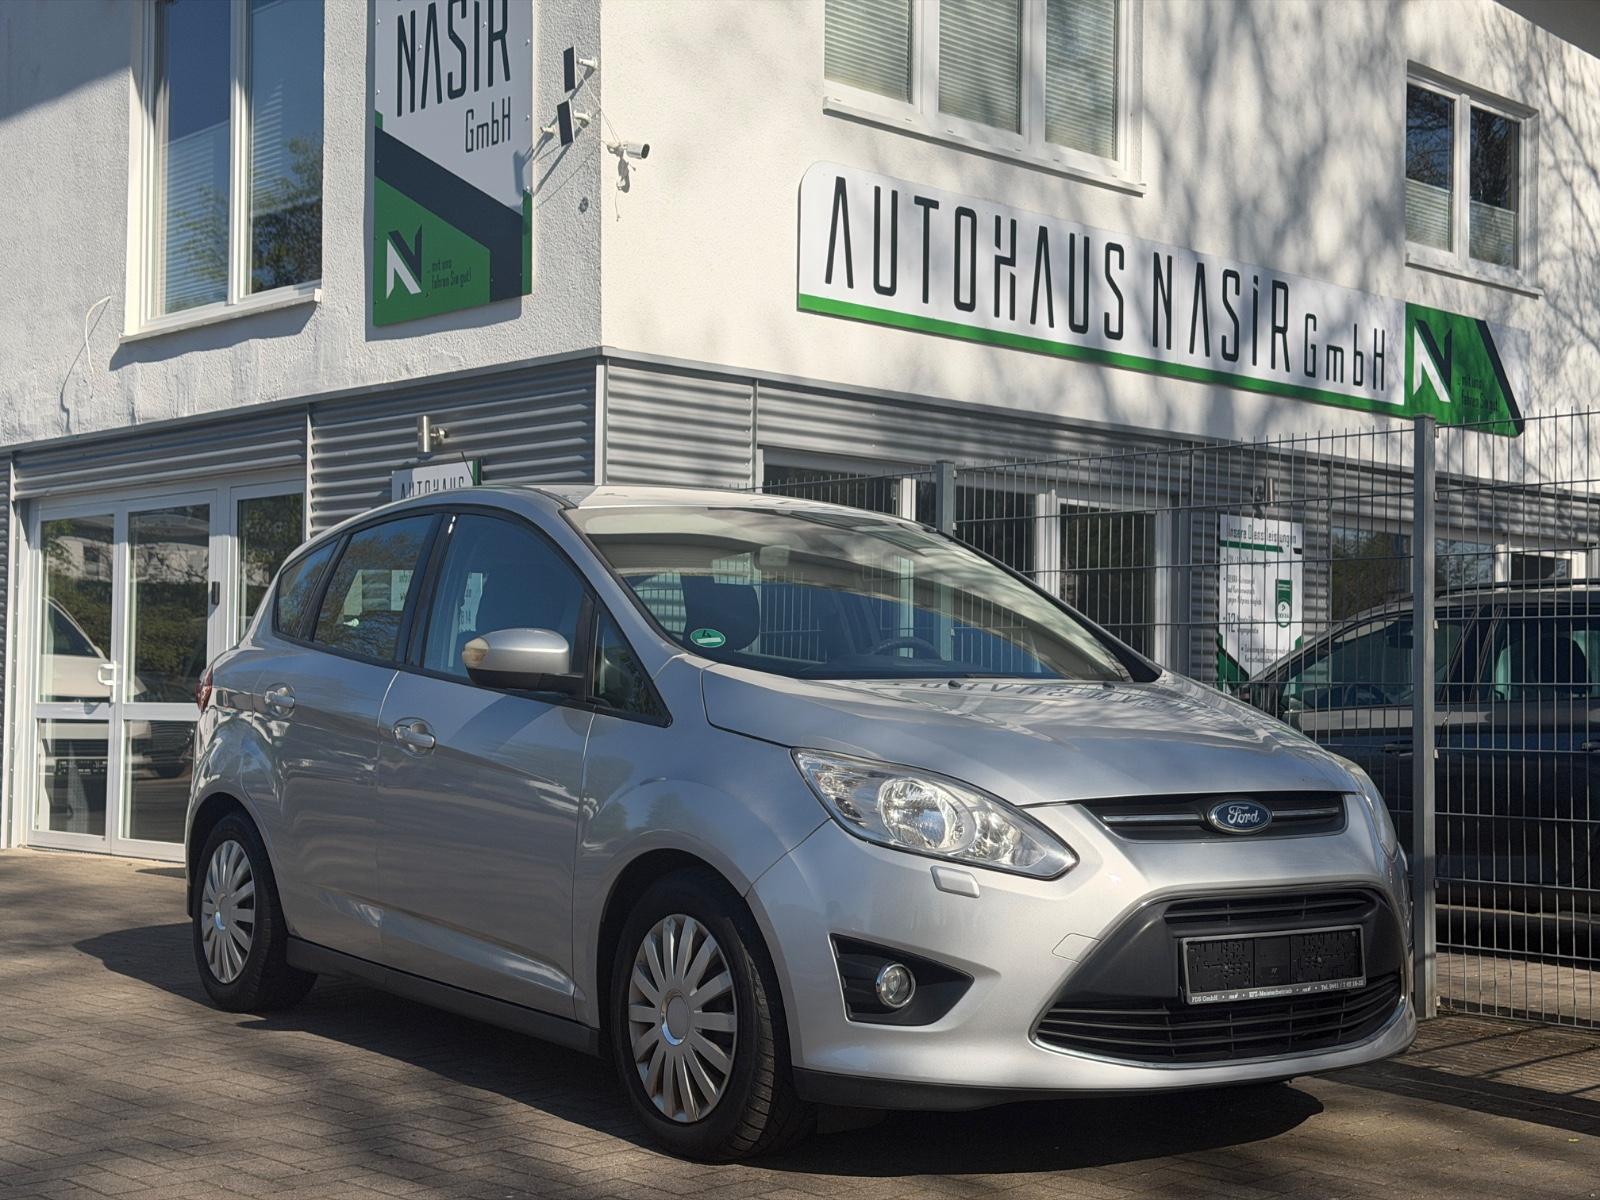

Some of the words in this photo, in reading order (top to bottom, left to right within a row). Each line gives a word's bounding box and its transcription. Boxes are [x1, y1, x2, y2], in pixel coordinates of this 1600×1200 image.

[465, 96, 511, 153] GmbH
[824, 176, 1125, 340] AUTOHAUS
[1303, 312, 1385, 392] GmbH
[1228, 524, 1247, 539] nsere
[1228, 612, 1236, 633] 12
[1227, 805, 1260, 824] Ford
